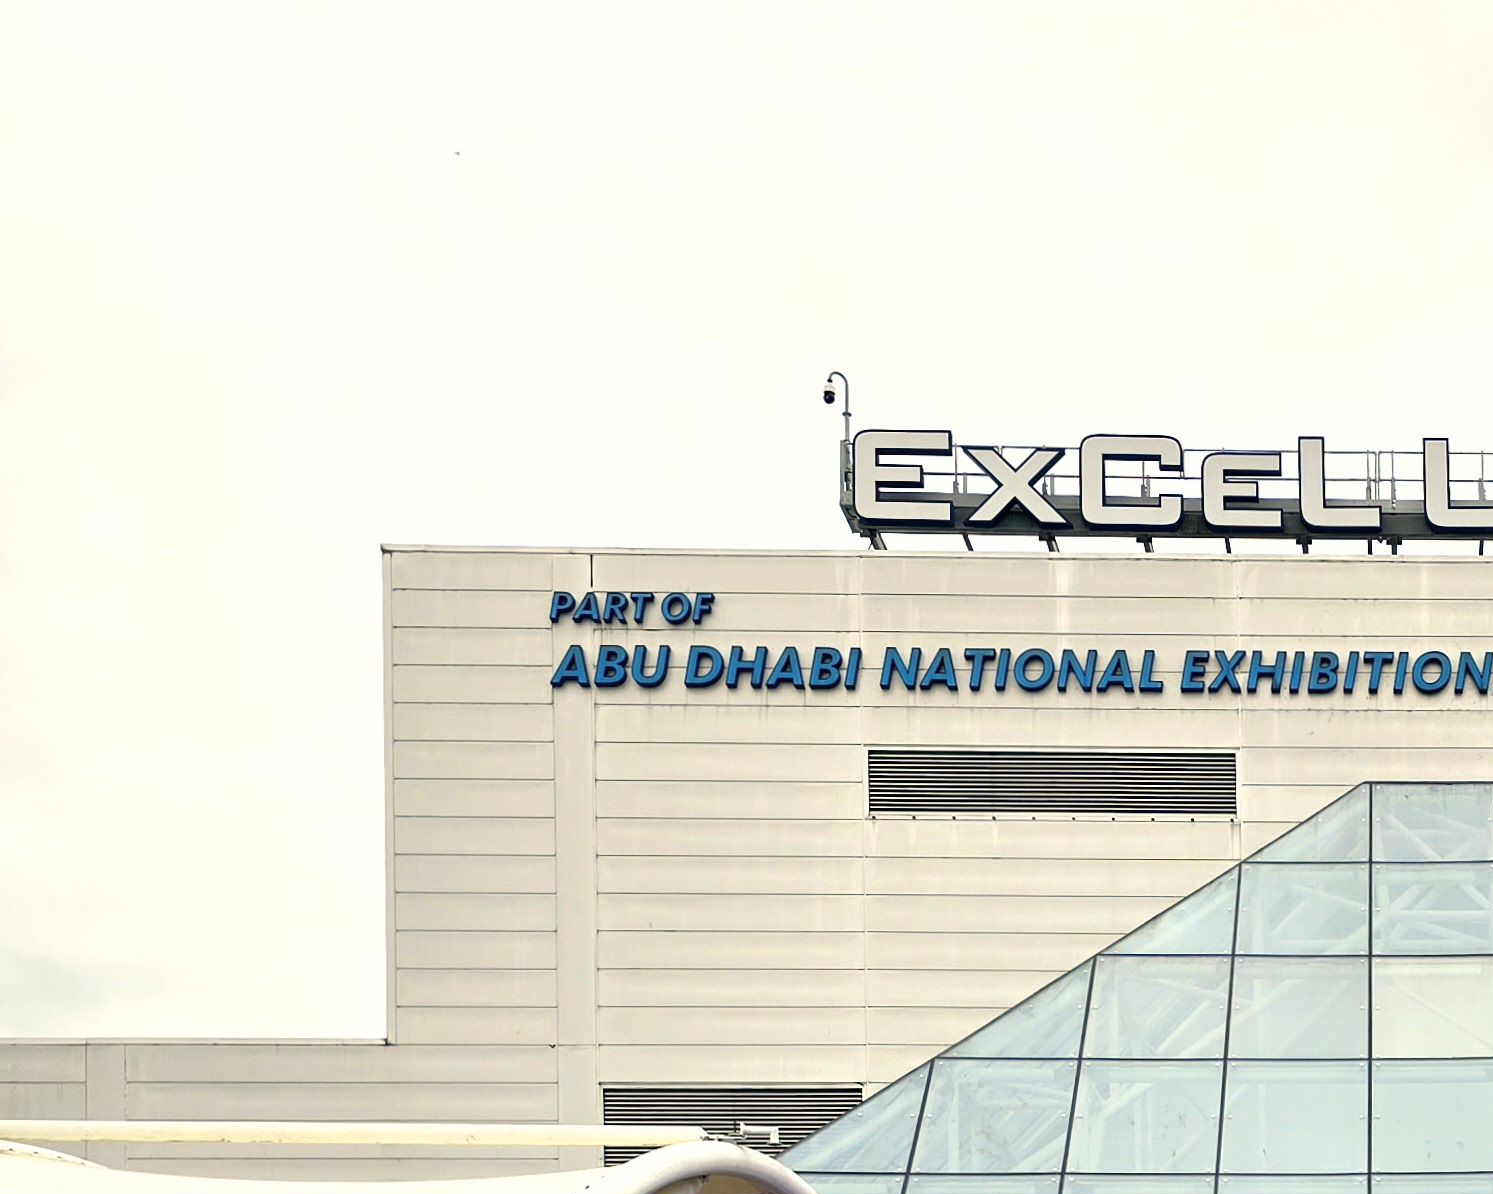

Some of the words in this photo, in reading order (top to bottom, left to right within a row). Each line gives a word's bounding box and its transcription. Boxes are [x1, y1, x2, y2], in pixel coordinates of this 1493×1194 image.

[549, 591, 653, 624] PART
[661, 592, 716, 625] OF
[551, 644, 671, 688] ABU
[685, 646, 862, 692] DHABI
[881, 647, 1165, 694] NATIONAL
